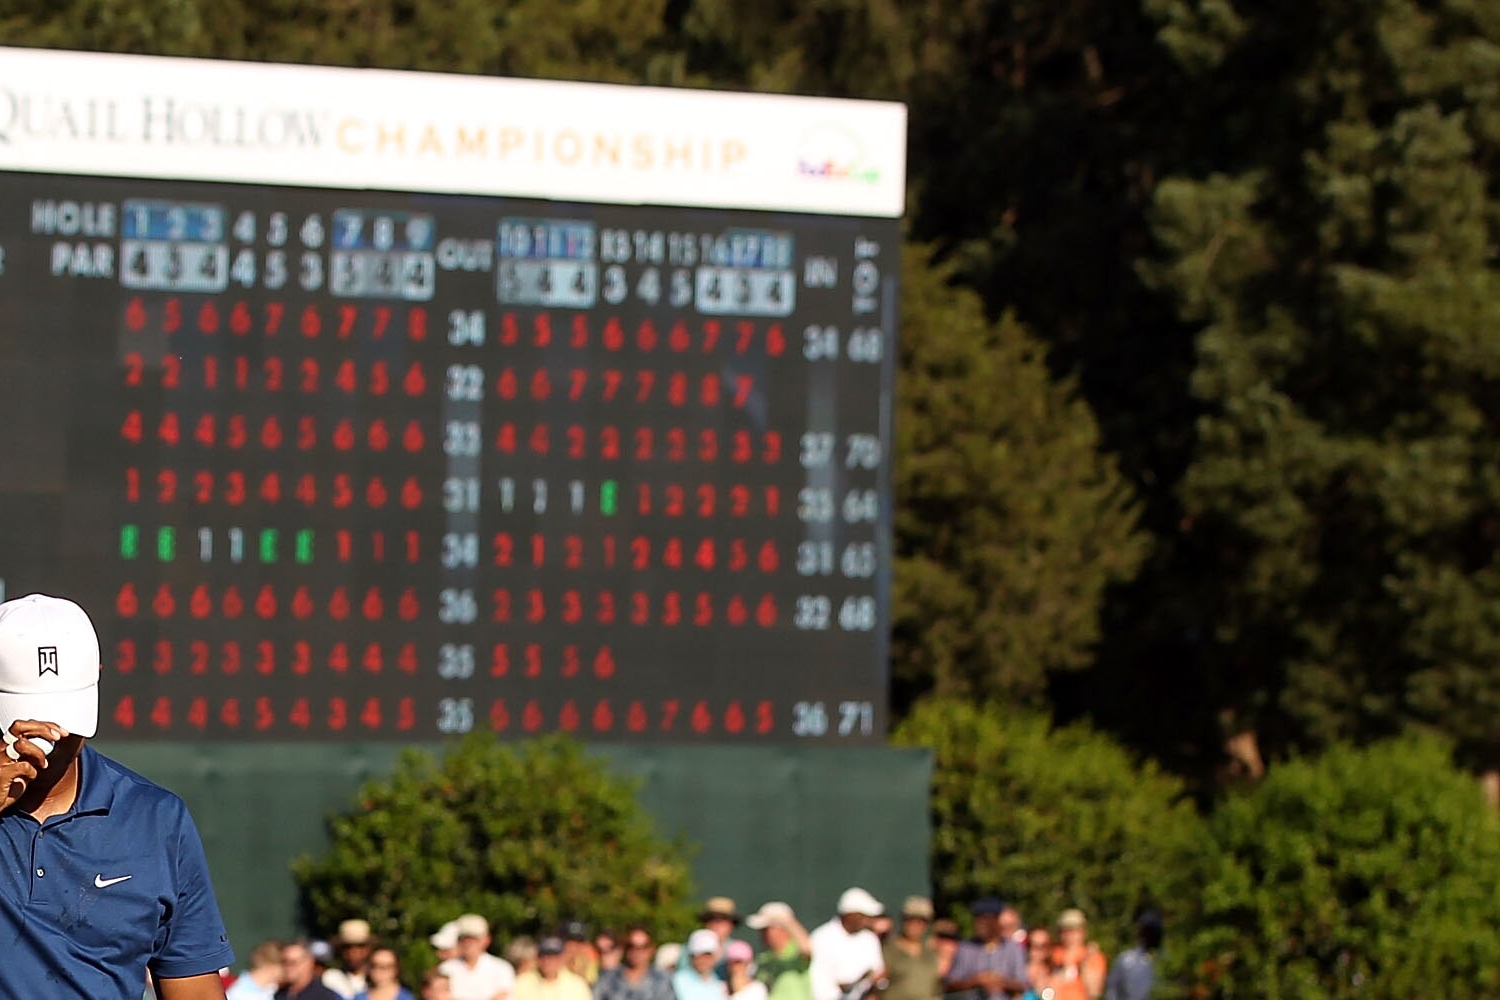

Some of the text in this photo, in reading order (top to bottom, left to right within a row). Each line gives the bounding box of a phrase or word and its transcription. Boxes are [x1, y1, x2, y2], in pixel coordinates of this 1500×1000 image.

[142, 95, 329, 149] HOLLOW
[336, 117, 748, 172] CHAMPIONSHIP
[31, 201, 115, 237] HOLE
[234, 213, 254, 242] 4
[436, 238, 494, 272] OUT
[52, 242, 114, 276] PAR
[131, 249, 148, 277] 4
[232, 250, 255, 284] 4
[301, 252, 322, 289] 3
[603, 265, 628, 303] 3
[638, 269, 659, 302] 4
[266, 302, 284, 335] 7
[338, 305, 358, 337] 7
[374, 307, 391, 337] 7
[703, 320, 721, 351] 7
[736, 322, 754, 352] 7
[205, 357, 217, 388] 1
[236, 357, 249, 388] 1
[300, 357, 319, 392] 2
[336, 359, 357, 393] 4
[569, 368, 588, 400] 7
[604, 370, 622, 400] 7
[637, 370, 655, 401] 7
[733, 375, 753, 408] 7
[121, 411, 143, 443] 4
[157, 412, 181, 445] 4
[195, 415, 216, 446] 4
[126, 467, 140, 502] 1
[197, 527, 213, 561] 1
[228, 527, 243, 561] 1
[337, 530, 352, 561] 1
[406, 531, 420, 562] 1
[531, 534, 545, 566] 1
[631, 536, 650, 570] 2
[116, 583, 138, 617] 6
[153, 584, 176, 618] 6
[189, 584, 212, 619] 6
[255, 585, 277, 619] 6
[328, 643, 350, 673] 4
[363, 643, 383, 673] 4
[114, 696, 136, 728] 4
[188, 698, 208, 727] 4
[289, 699, 311, 727] 4
[360, 698, 383, 728] 4
[663, 700, 679, 728] 7
[838, 701, 873, 735] 71
